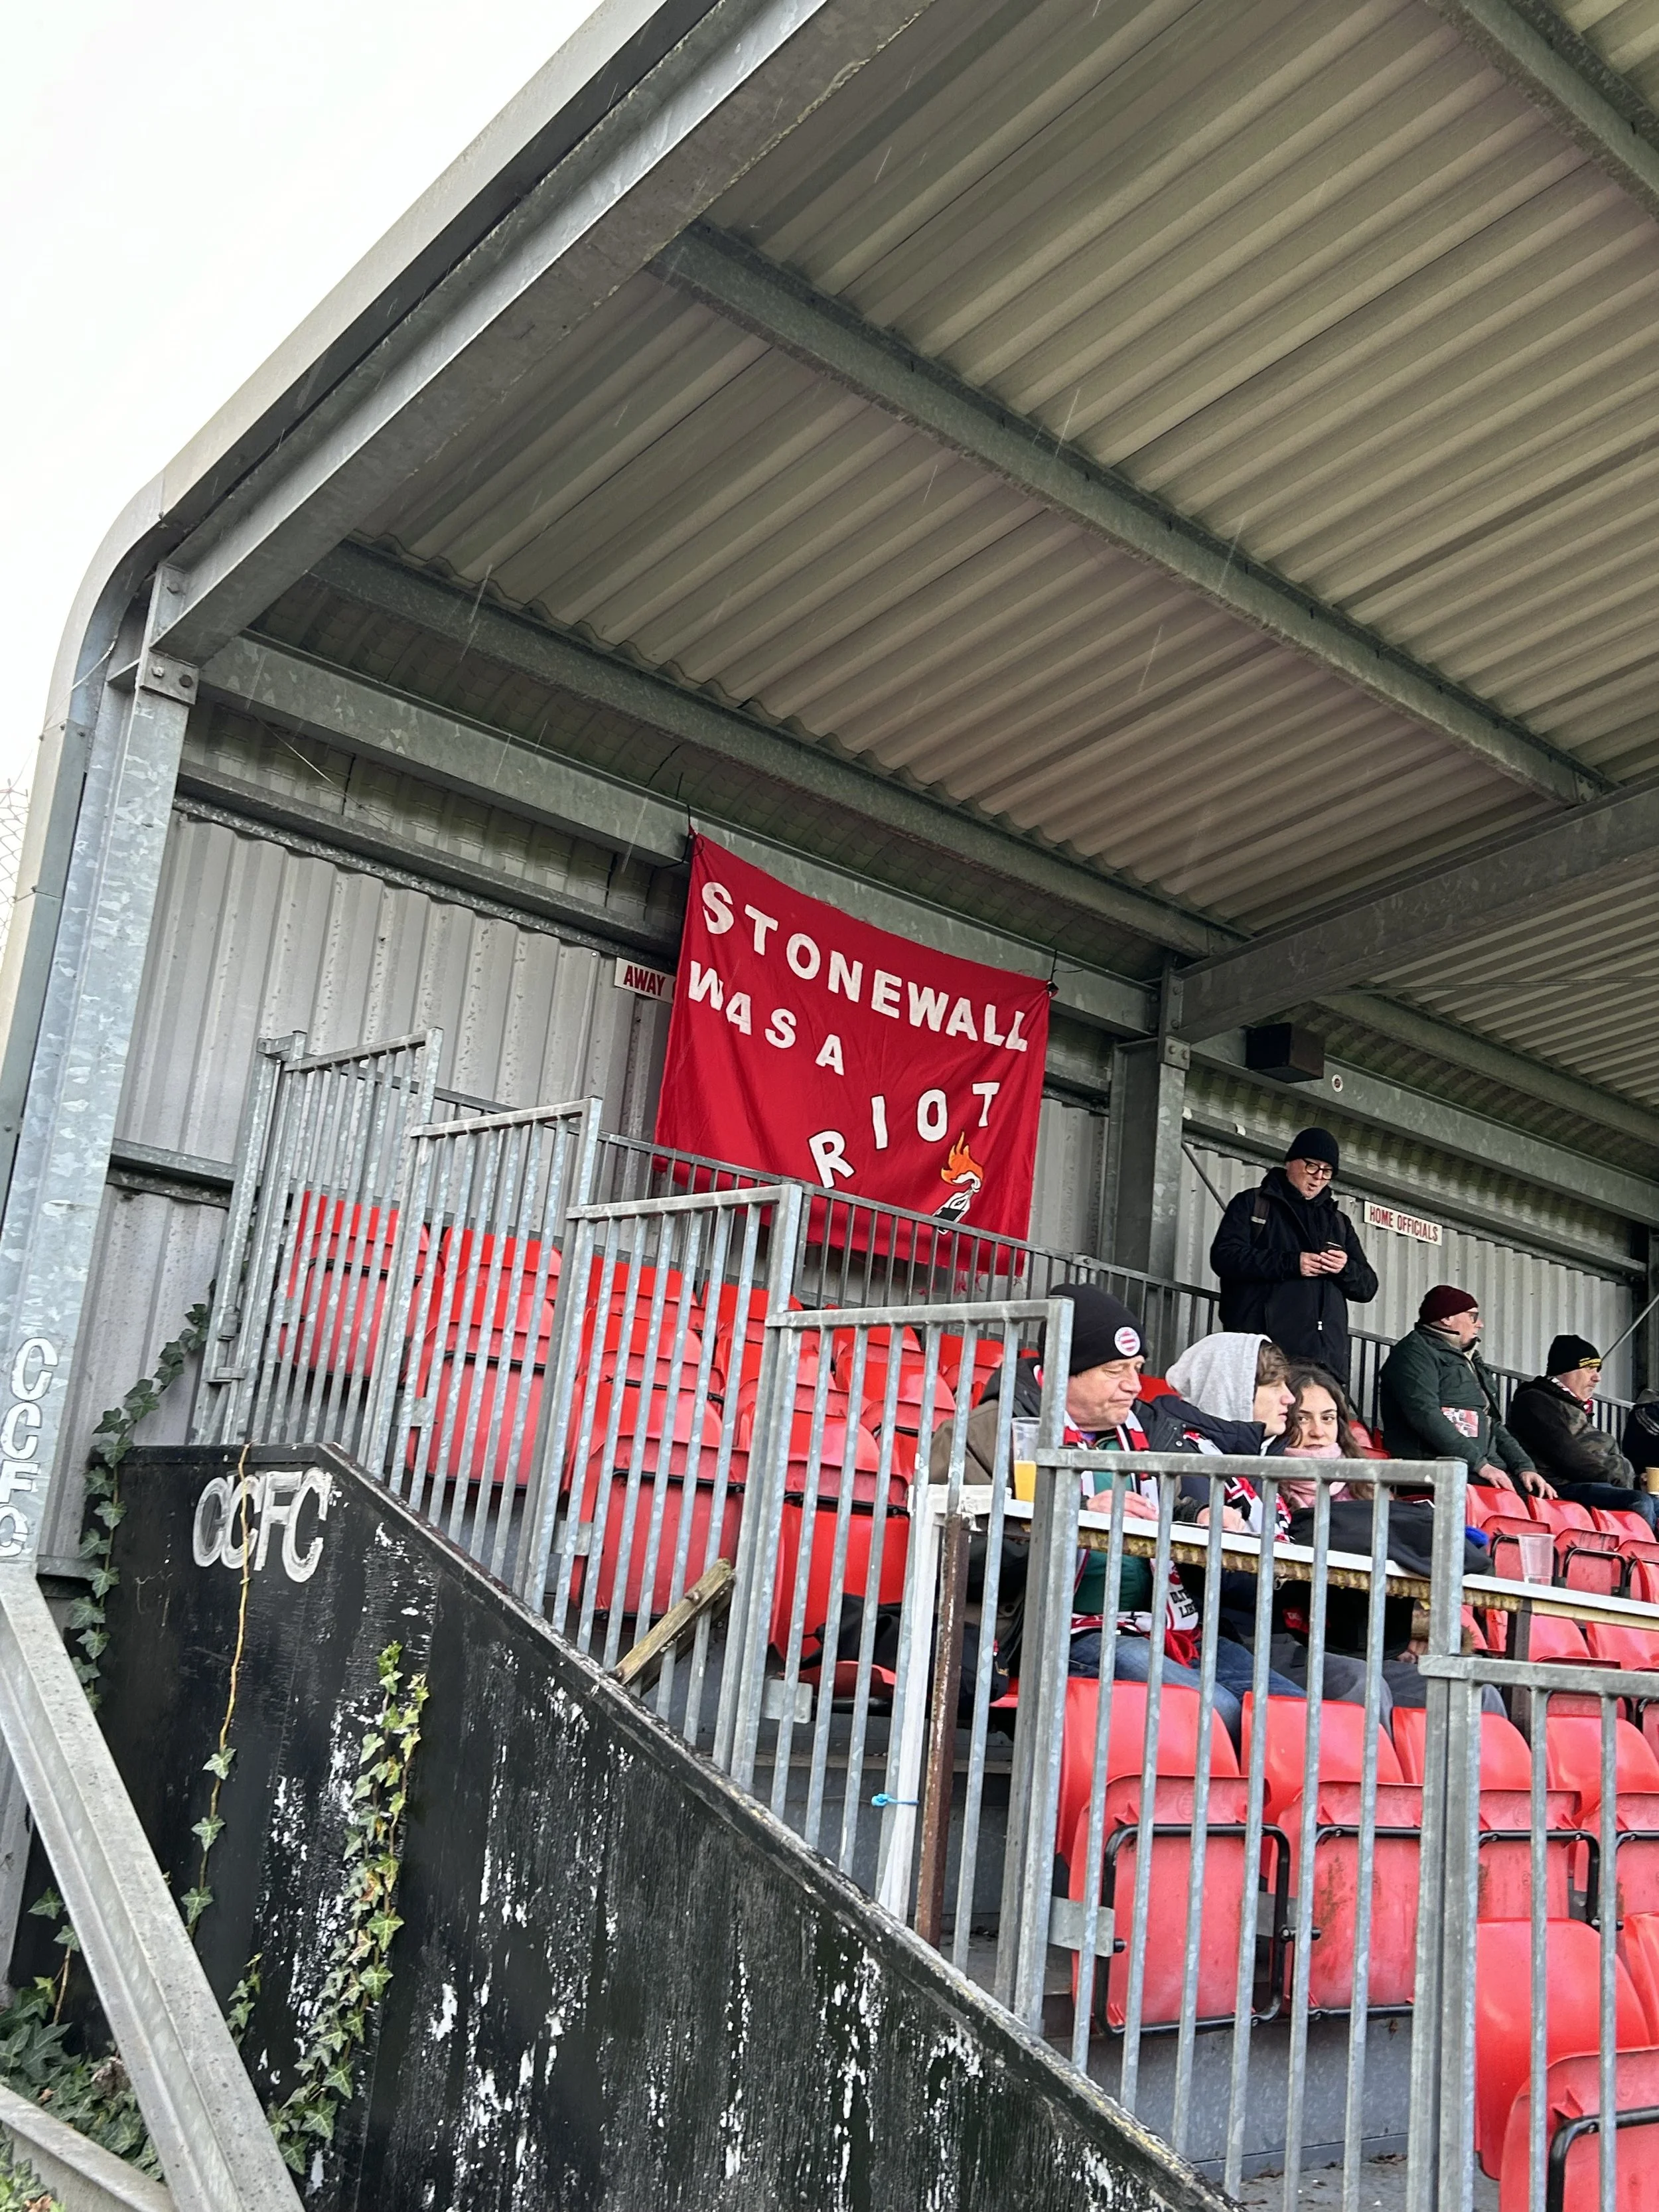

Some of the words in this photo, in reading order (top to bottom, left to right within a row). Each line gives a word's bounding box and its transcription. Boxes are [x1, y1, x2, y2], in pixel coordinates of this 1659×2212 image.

[623, 964, 666, 996] AWAY
[687, 960, 797, 1049] WAS
[816, 1033, 845, 1076] A
[701, 881, 1028, 1052] STONEWALL
[808, 1082, 1000, 1189] RIOT
[1370, 1205, 1394, 1228] HOME
[1397, 1215, 1438, 1242] OFFICIALS
[192, 1467, 332, 1583] CCFC
